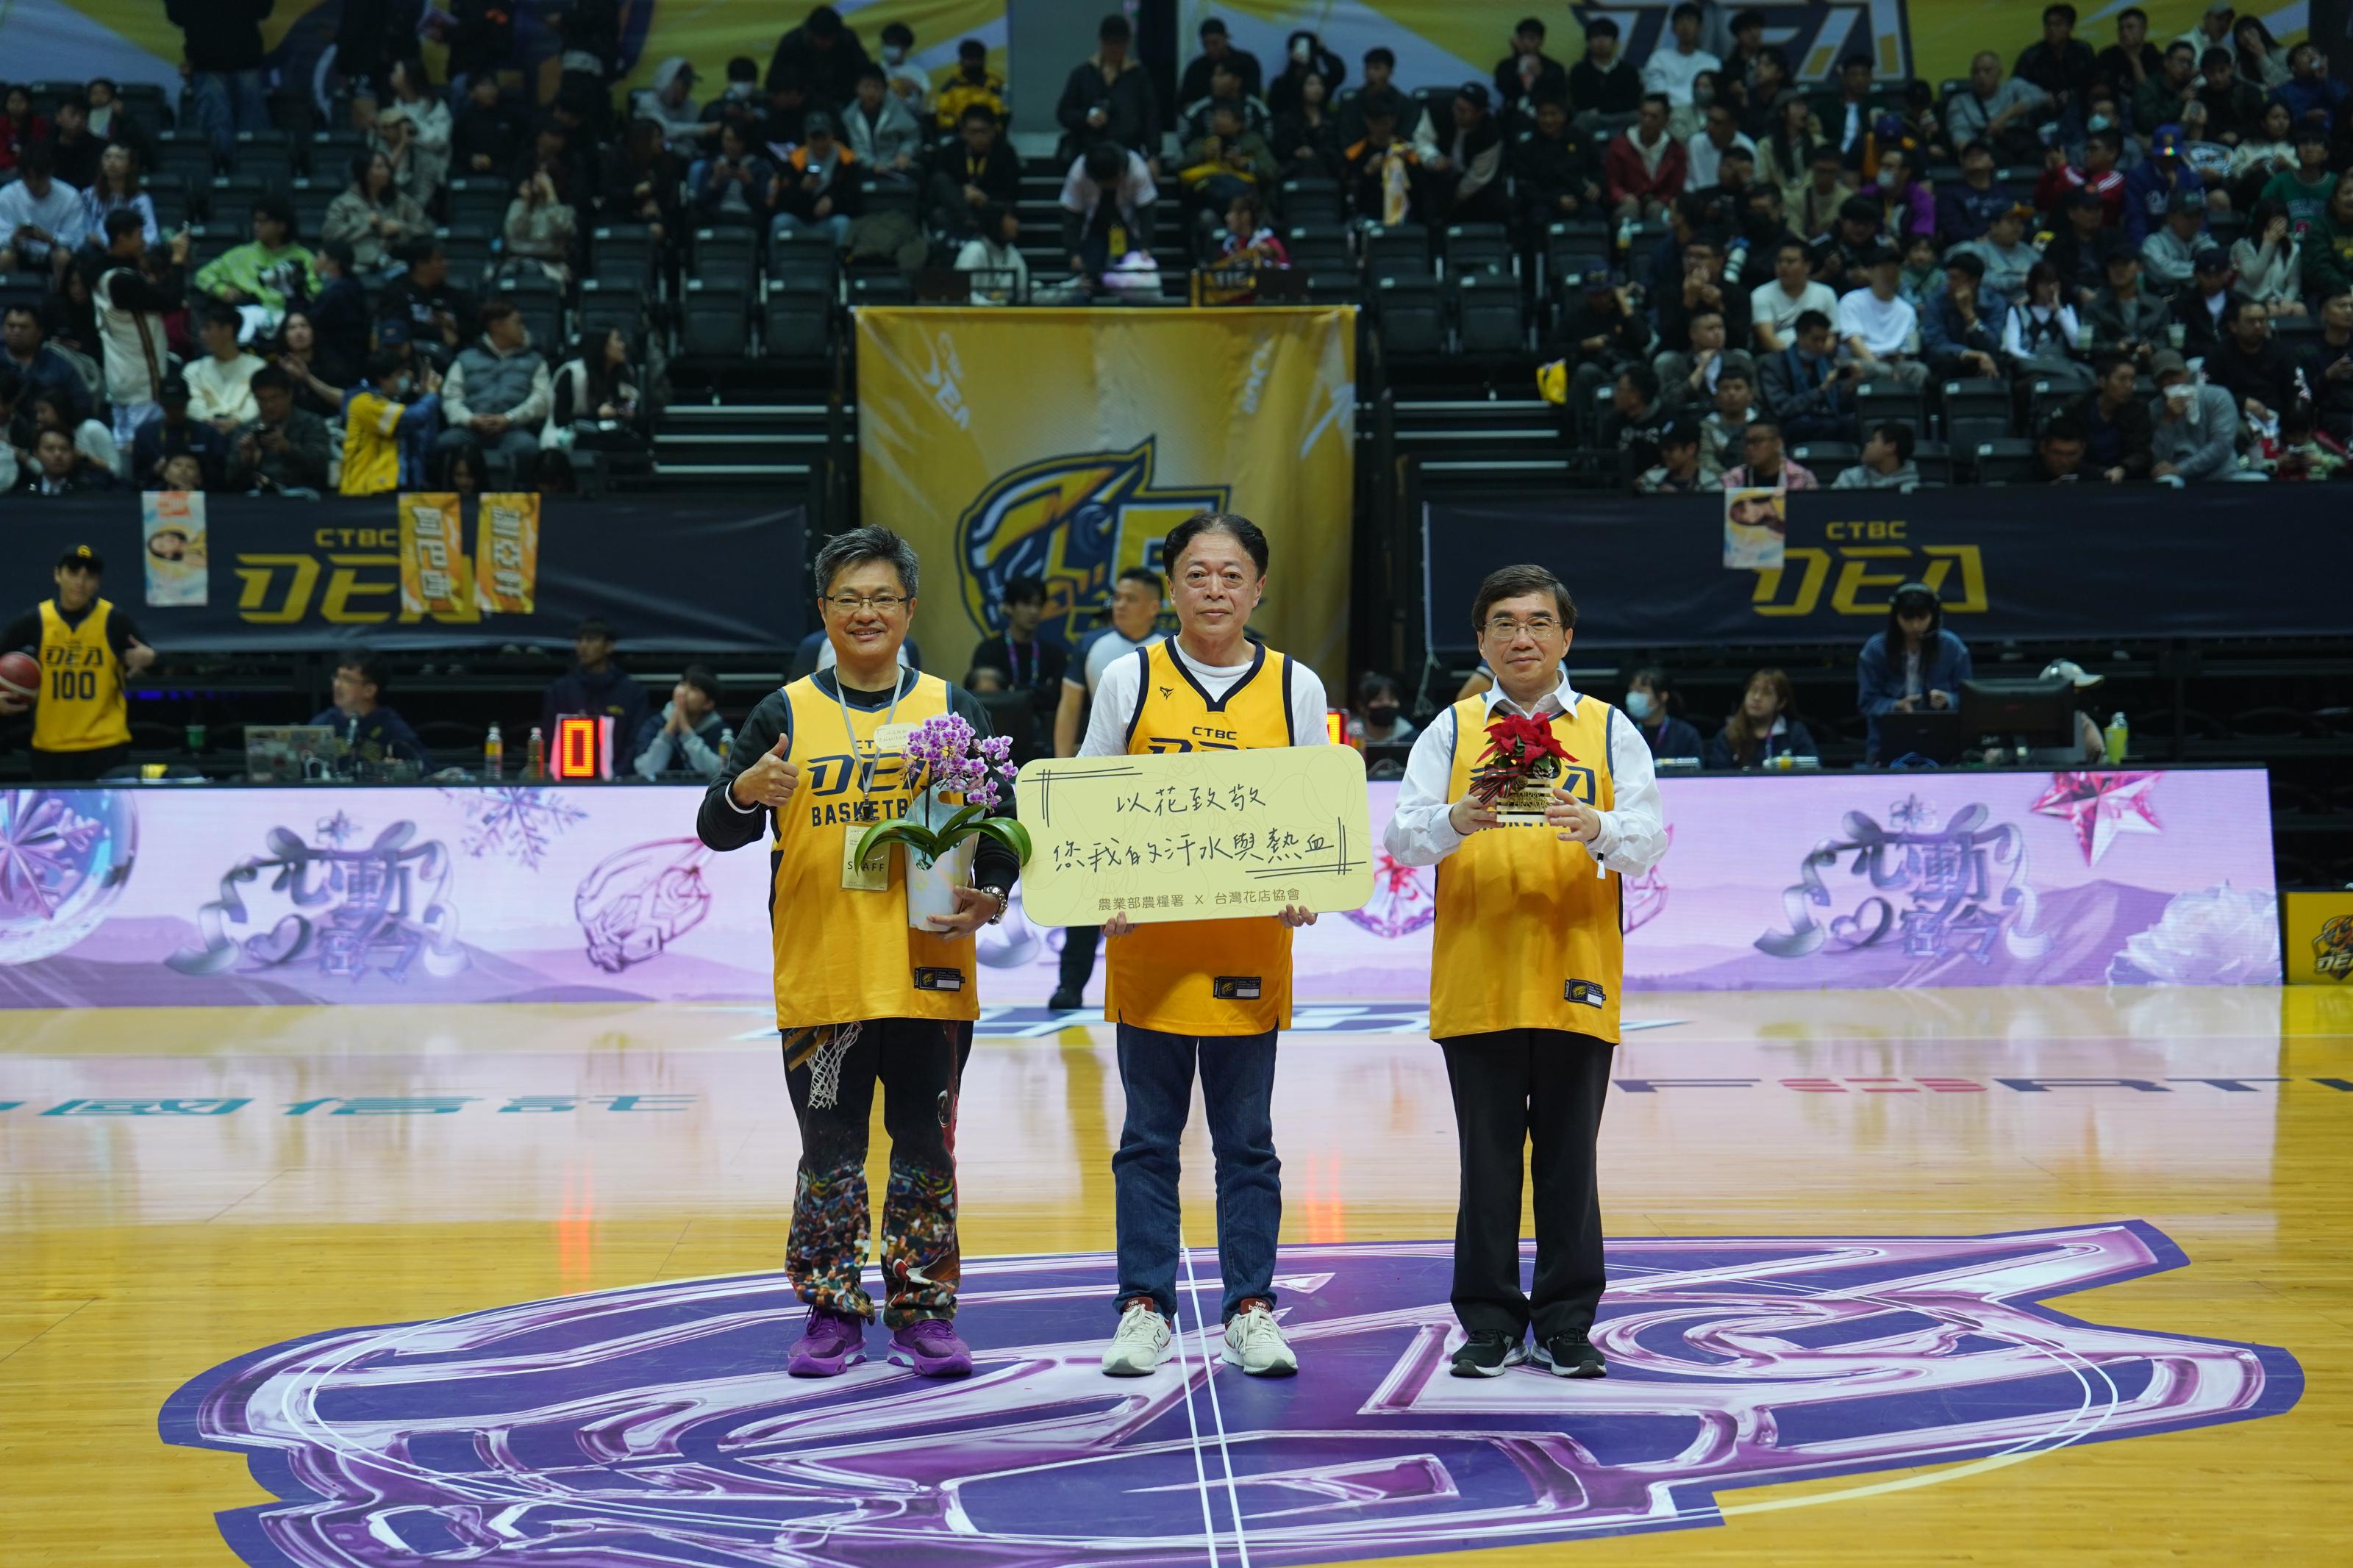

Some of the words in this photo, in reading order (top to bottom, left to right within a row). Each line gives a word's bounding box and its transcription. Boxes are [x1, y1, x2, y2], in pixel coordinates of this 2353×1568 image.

[315, 529, 399, 548] CTBC
[1826, 521, 1907, 540] CTBC
[1752, 545, 1988, 617] DEA
[44, 646, 104, 667] DEA
[51, 670, 96, 700] 100
[1192, 726, 1237, 740] CTBC
[563, 720, 594, 776] 0
[1116, 785, 1266, 817] 以花致敬
[1053, 828, 1335, 873] 您我的汗水與熱血
[847, 861, 885, 872] SAFF
[1098, 894, 1185, 912] 農業部農糧署
[1214, 887, 1300, 905] 台灣花店協會
[2316, 953, 2353, 974] DE
[0, 1094, 699, 1116] 國信託
